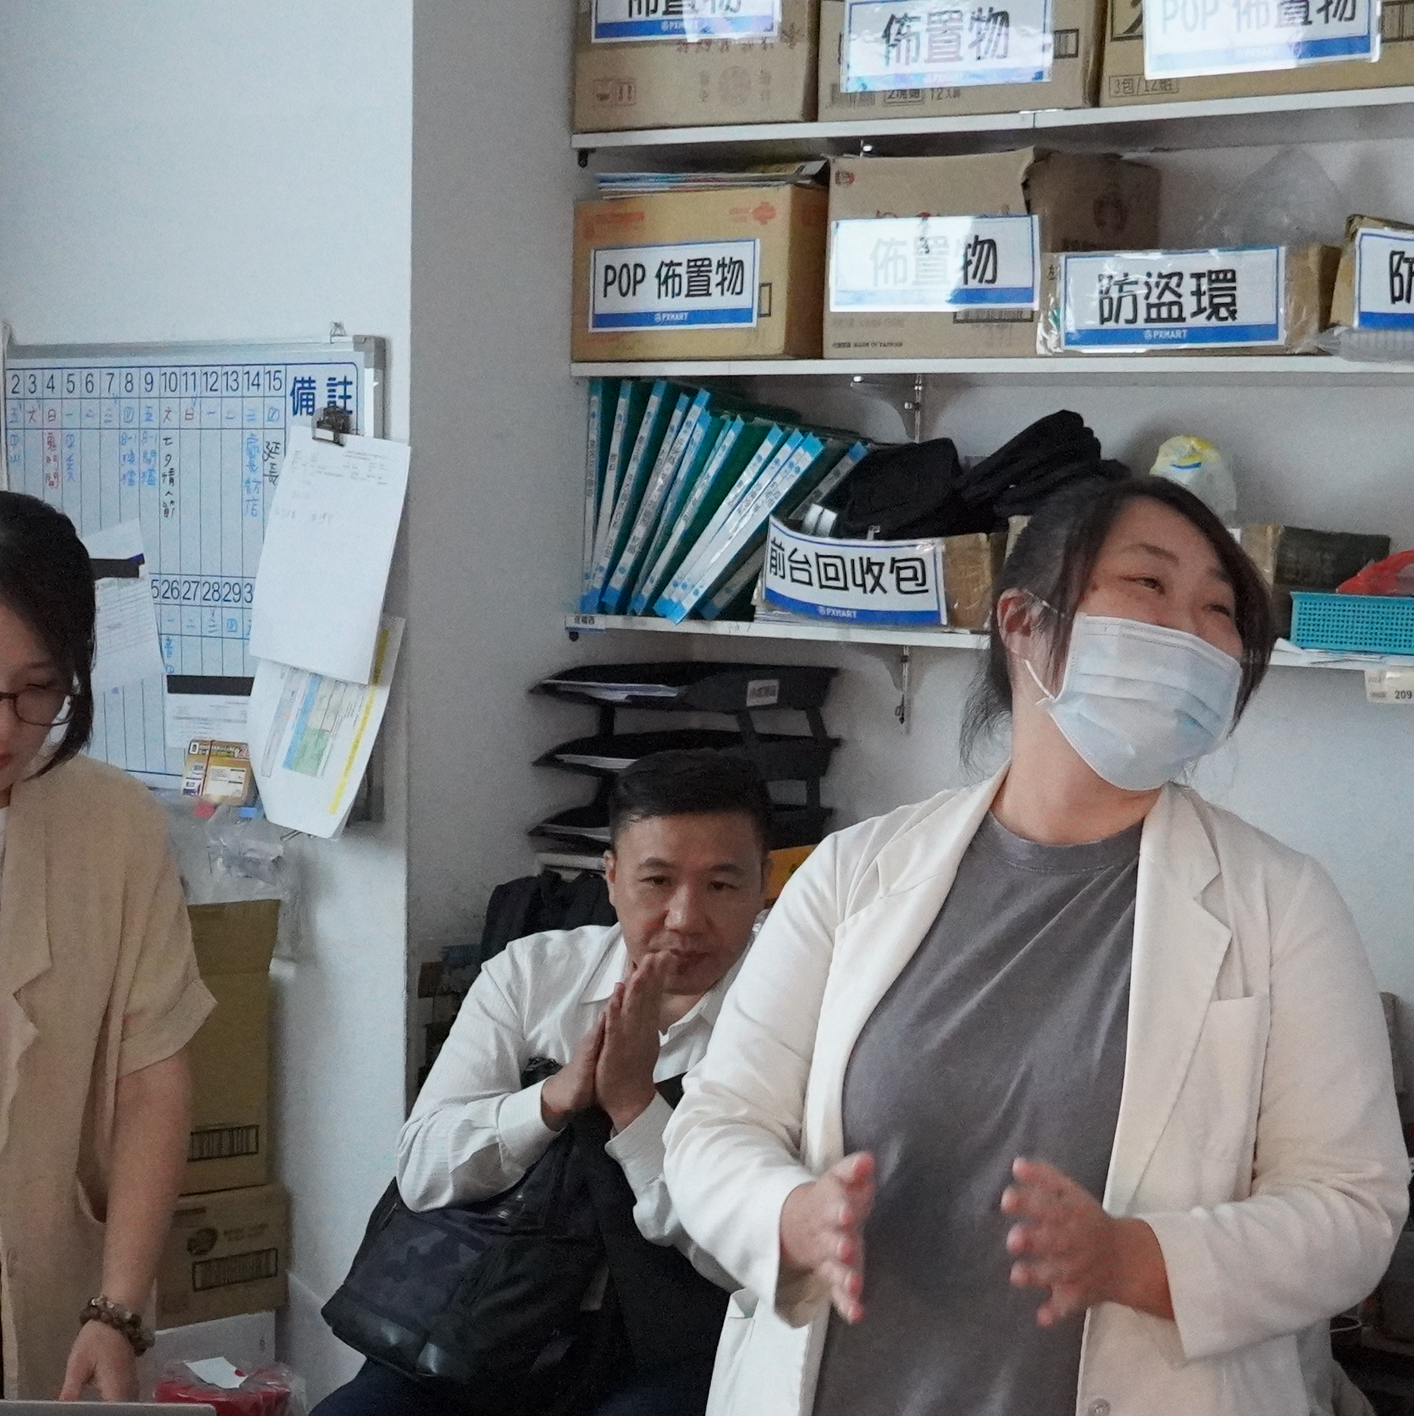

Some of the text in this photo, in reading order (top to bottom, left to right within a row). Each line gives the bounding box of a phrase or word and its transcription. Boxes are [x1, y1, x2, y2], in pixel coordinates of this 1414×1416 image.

[883, 7, 1011, 66] 佈置物
[602, 256, 745, 300] POP 佈置物
[1097, 267, 1239, 326] 防盜環
[660, 311, 690, 323] PXMART
[1152, 329, 1188, 340] PXMART
[10, 370, 354, 417] 2 3 4 5 6 7 8 9 10 11 12 13 14 15 備註
[769, 537, 930, 595] 前台回收包
[161, 579, 181, 600] 26
[182, 580, 200, 601] 27
[202, 581, 221, 602] 28
[222, 582, 242, 603] 29
[825, 608, 858, 620] PXMART
[1394, 690, 1413, 700] 209
